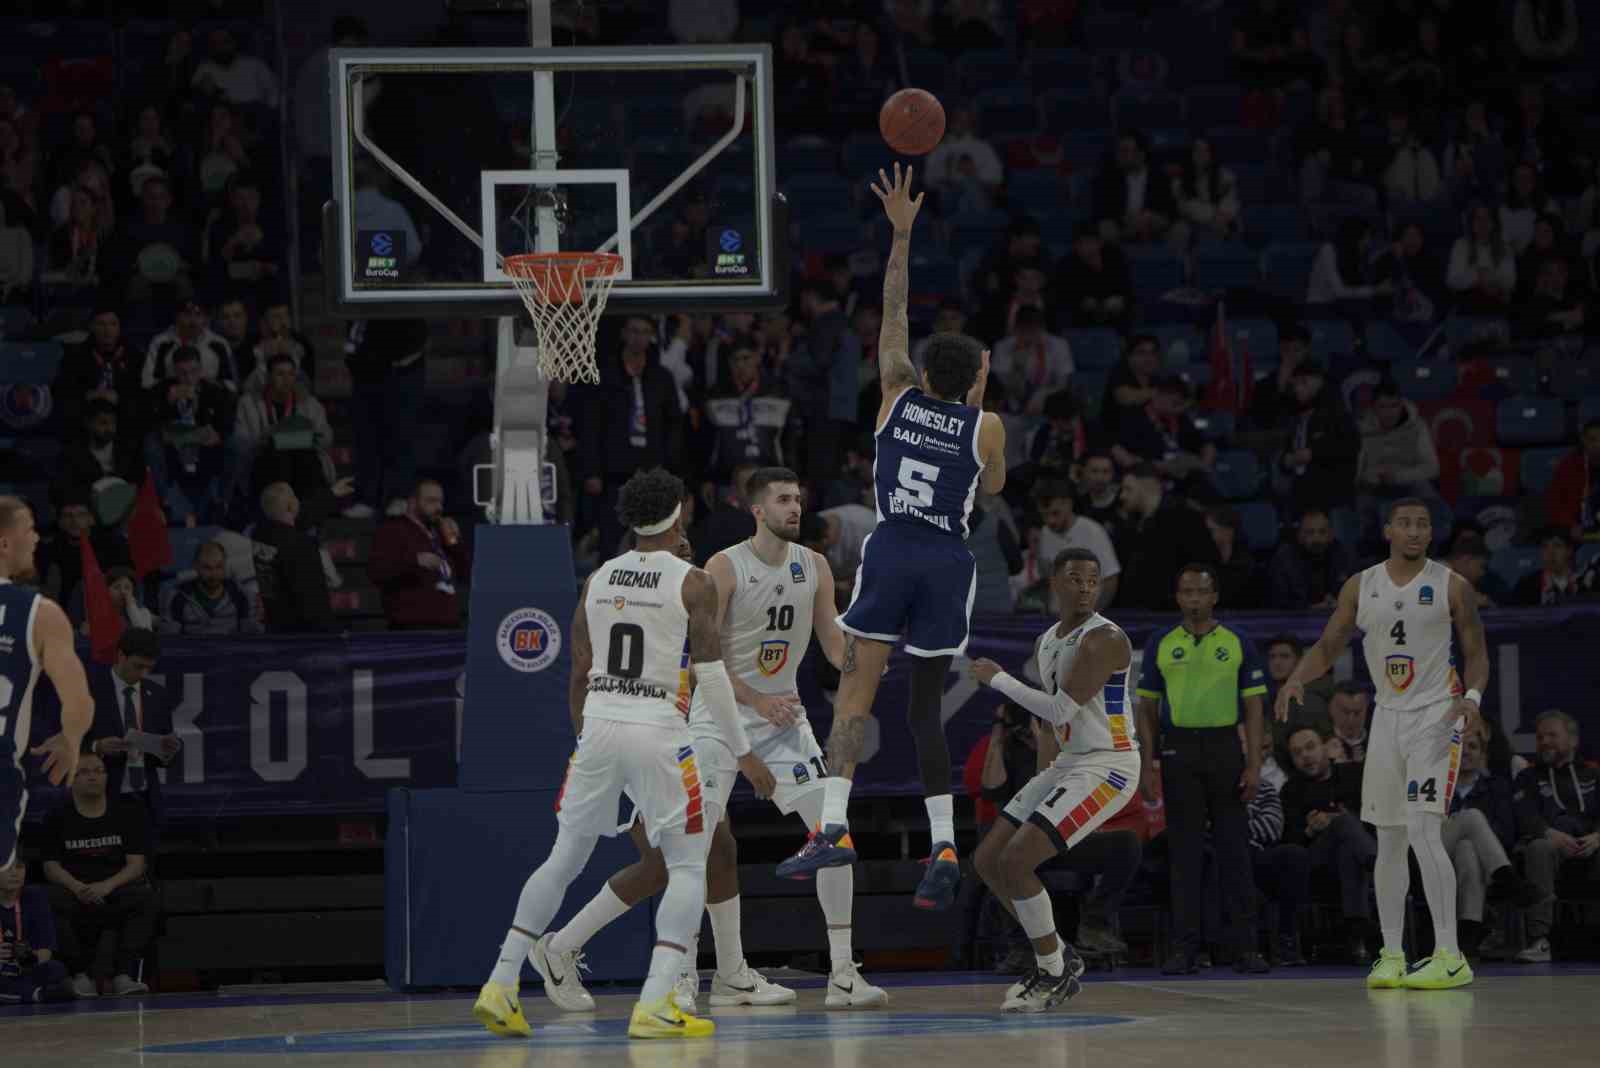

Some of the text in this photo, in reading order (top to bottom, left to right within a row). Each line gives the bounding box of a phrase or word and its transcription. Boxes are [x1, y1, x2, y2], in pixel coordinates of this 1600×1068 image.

[365, 268, 400, 280] EuroCup
[901, 402, 964, 436] HOMESLEY
[893, 426, 922, 446] BAU
[898, 455, 940, 508] 5
[608, 569, 662, 589] GUZMAN
[766, 605, 794, 631] 10
[514, 629, 545, 652] BK
[1390, 620, 1407, 646] 4
[607, 622, 644, 679] 0
[763, 648, 784, 661] BT
[1391, 664, 1408, 676] BT
[1045, 786, 1067, 808] 1
[1420, 778, 1437, 802] 4
